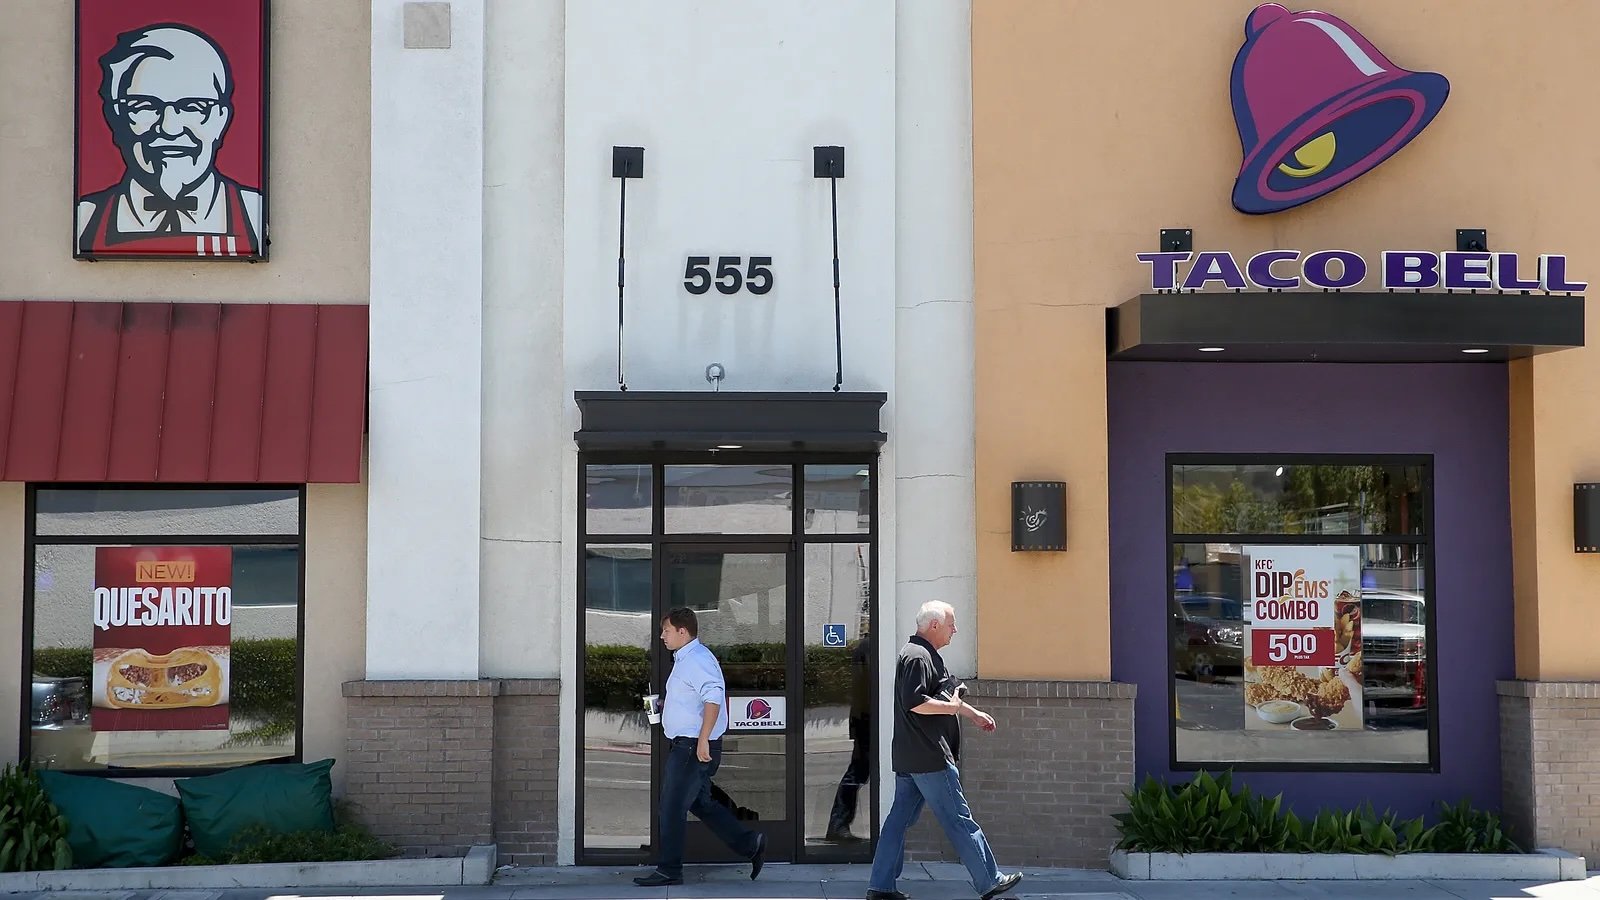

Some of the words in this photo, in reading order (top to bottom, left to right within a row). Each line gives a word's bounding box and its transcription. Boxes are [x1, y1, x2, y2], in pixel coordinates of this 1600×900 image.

[683, 256, 774, 295] 555
[1136, 250, 1367, 291] TACO
[1381, 251, 1587, 292] BELL
[139, 564, 192, 580] NEW!
[1255, 559, 1273, 570] KFC
[93, 586, 232, 631] QUESARITO
[1255, 599, 1319, 621] COMBO
[1268, 633, 1317, 662] 500
